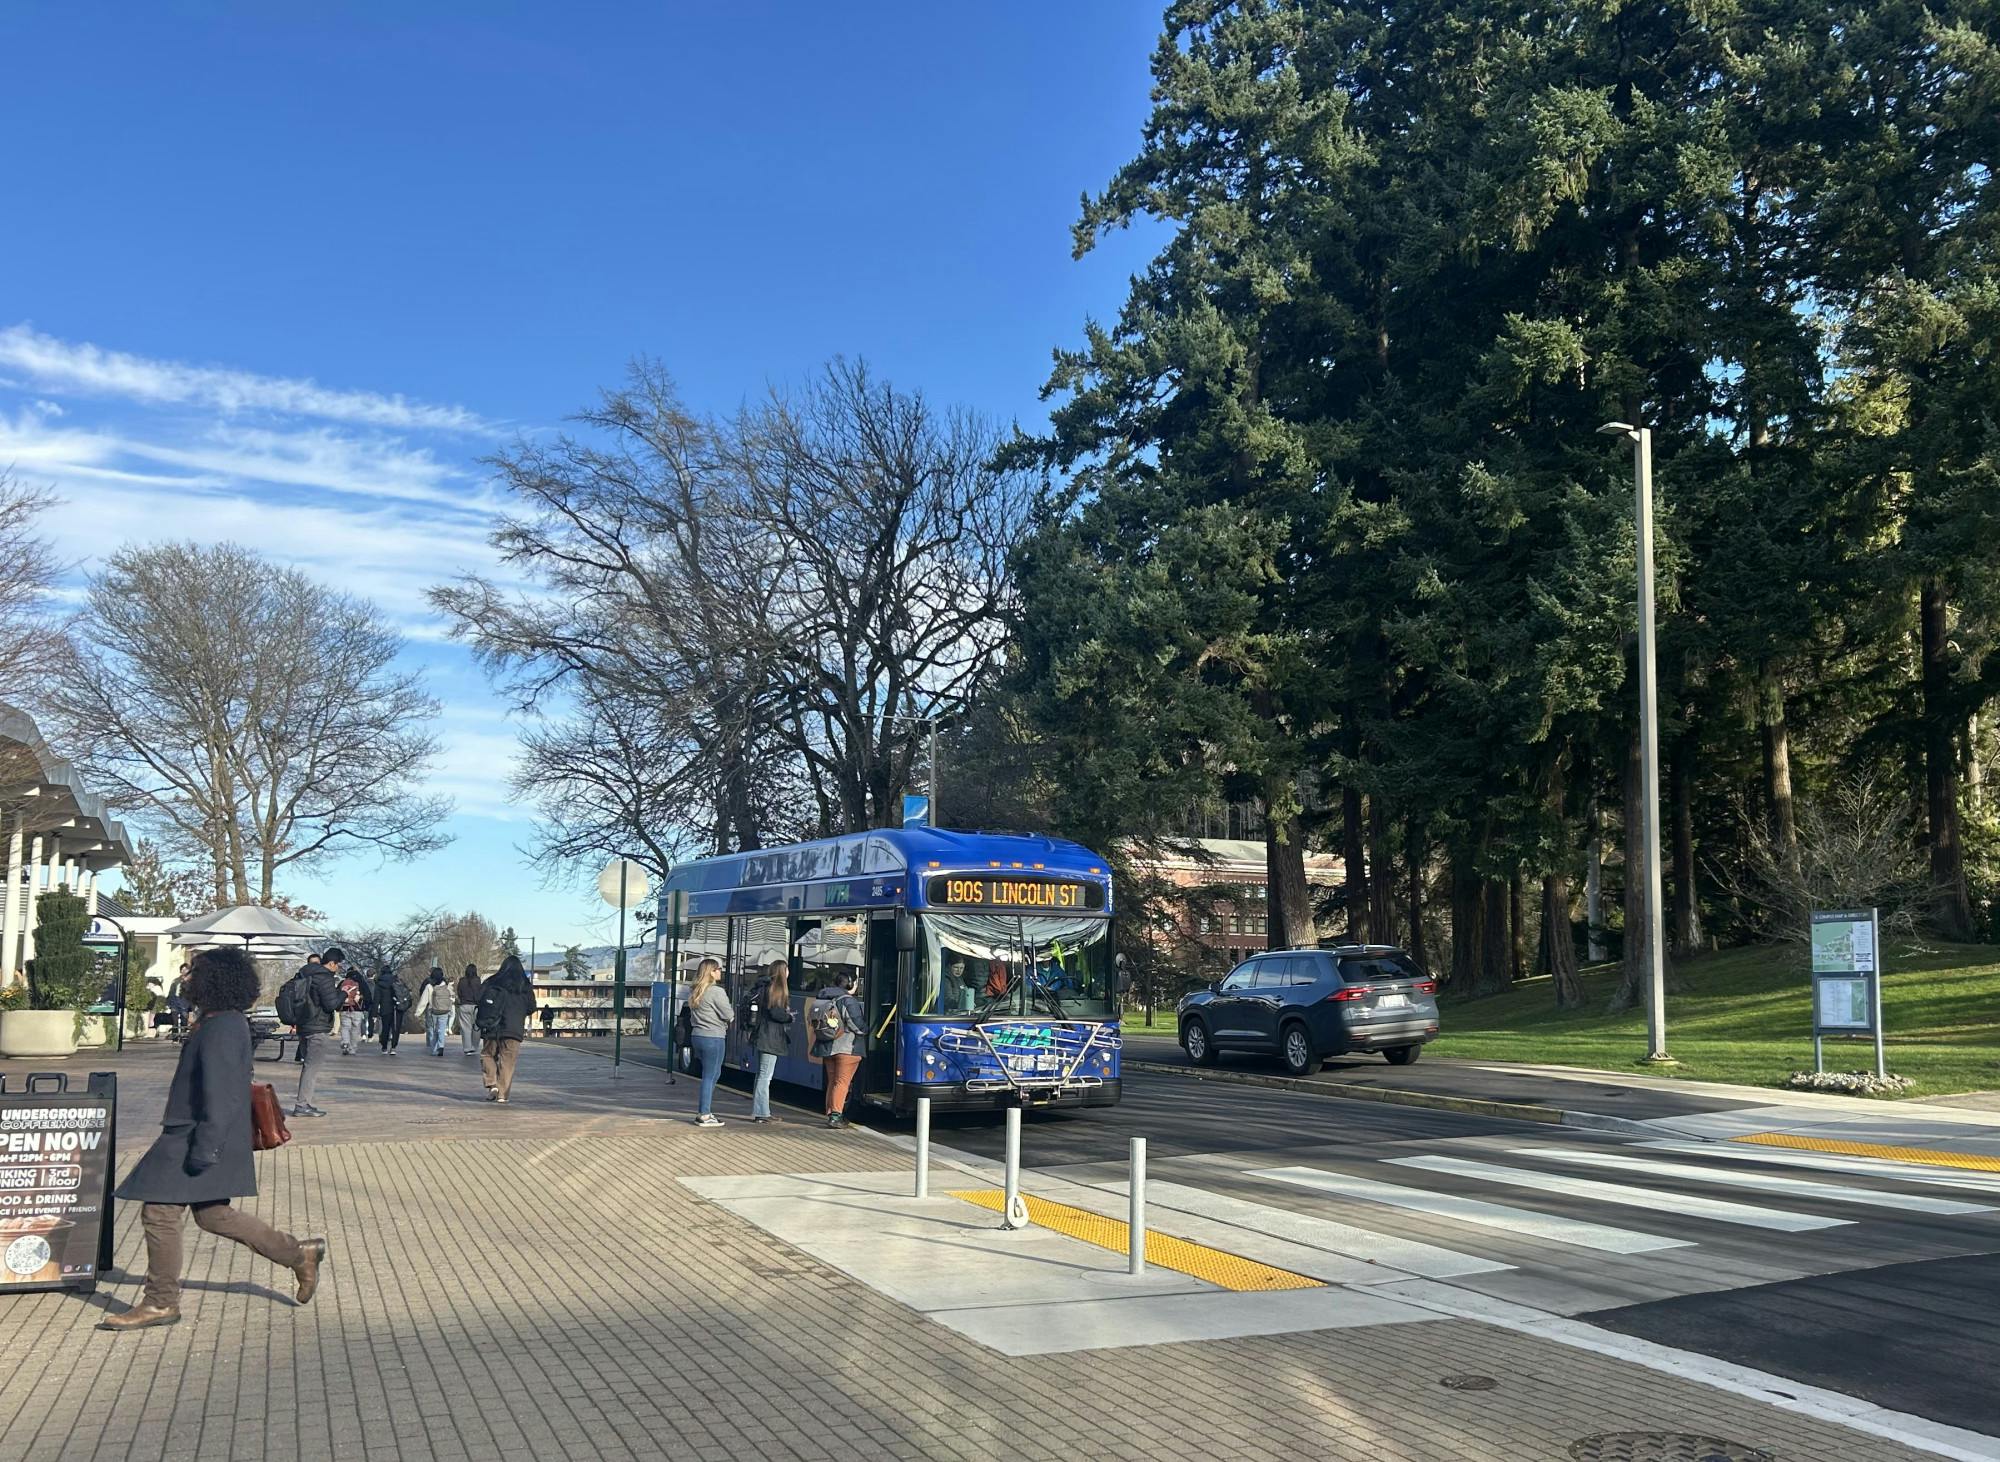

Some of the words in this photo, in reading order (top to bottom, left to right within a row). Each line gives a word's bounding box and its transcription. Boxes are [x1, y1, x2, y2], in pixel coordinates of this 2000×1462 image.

[946, 880, 983, 903] 190S
[992, 882, 1055, 906] LINCOLN
[1059, 884, 1078, 905] ST
[1, 1108, 106, 1120] UNDERGROUND
[0, 1119, 105, 1129] COFFEEHOUSE
[0, 1132, 41, 1152] PEN
[44, 1131, 102, 1151] NOW
[19, 1153, 43, 1162] 12PM
[49, 1153, 71, 1162] 6PM
[0, 1169, 37, 1178] IKING
[49, 1168, 70, 1177] 3rd
[0, 1178, 35, 1188] NION
[48, 1177, 78, 1186] floor
[23, 1196, 33, 1205] &
[35, 1194, 78, 1204] DRINKS
